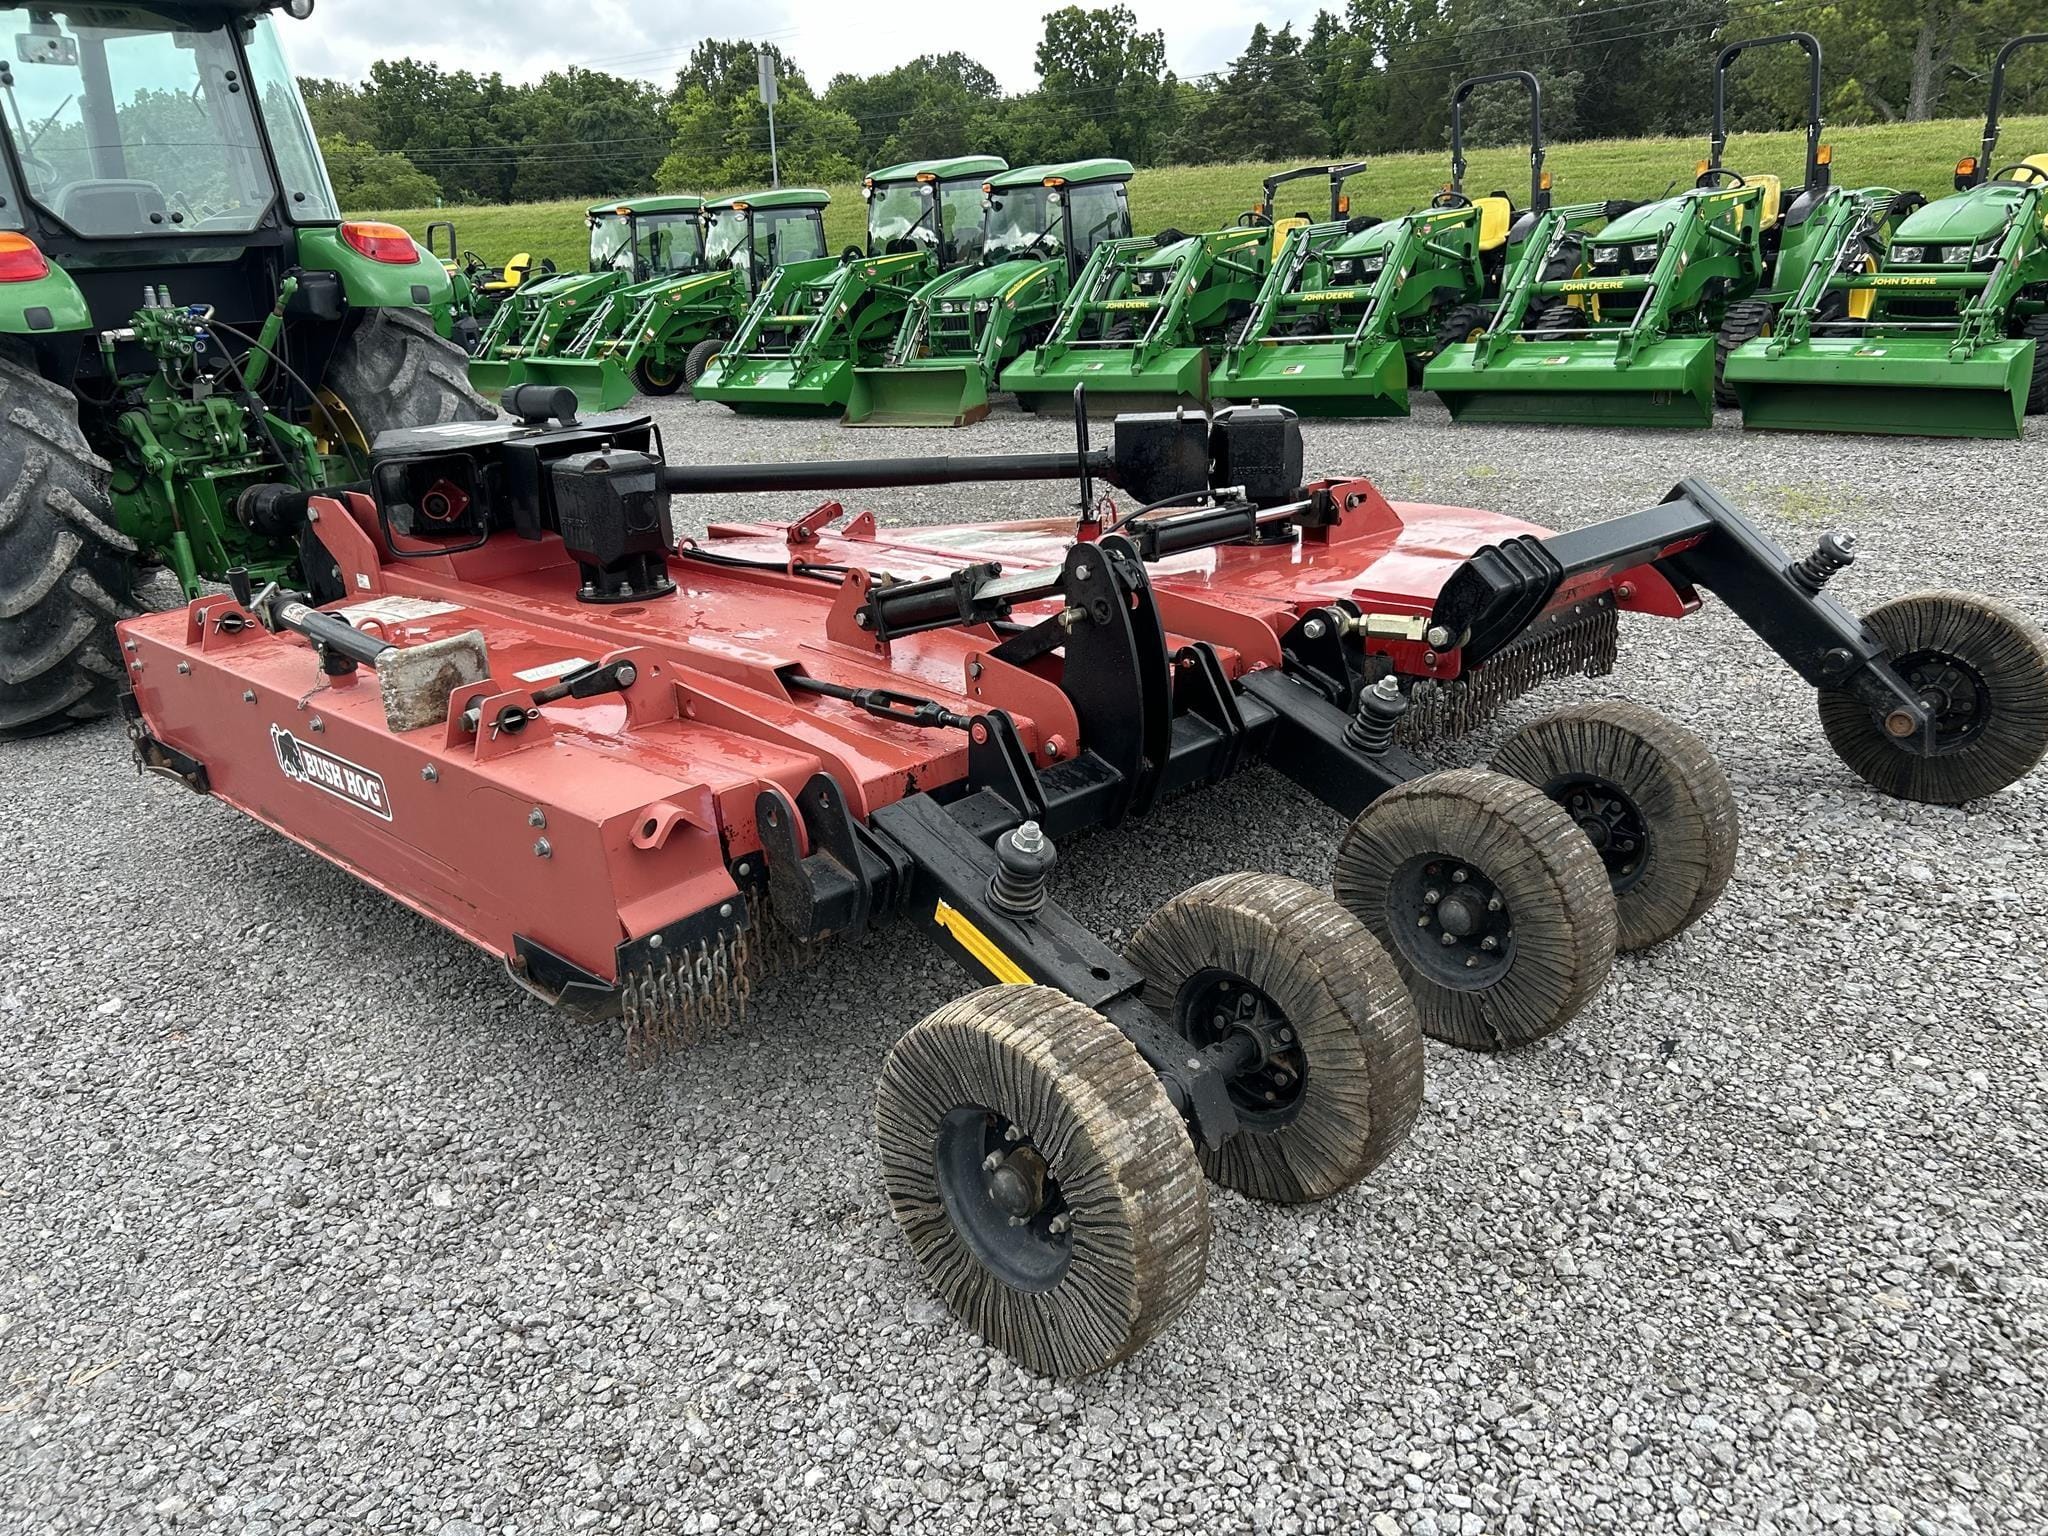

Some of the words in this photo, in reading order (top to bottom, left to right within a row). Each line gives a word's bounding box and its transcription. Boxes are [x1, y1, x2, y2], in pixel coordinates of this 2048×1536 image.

[1559, 282, 1588, 292] JOHN
[1588, 281, 1625, 290] DEERE
[1870, 277, 1900, 286] JOHN
[1900, 276, 1937, 285] DEERE
[1302, 294, 1325, 302] JOHN
[1326, 291, 1355, 300] DEERE
[1125, 301, 1150, 309] DEERE
[302, 750, 346, 791] BUSH
[343, 768, 382, 808] HOG
